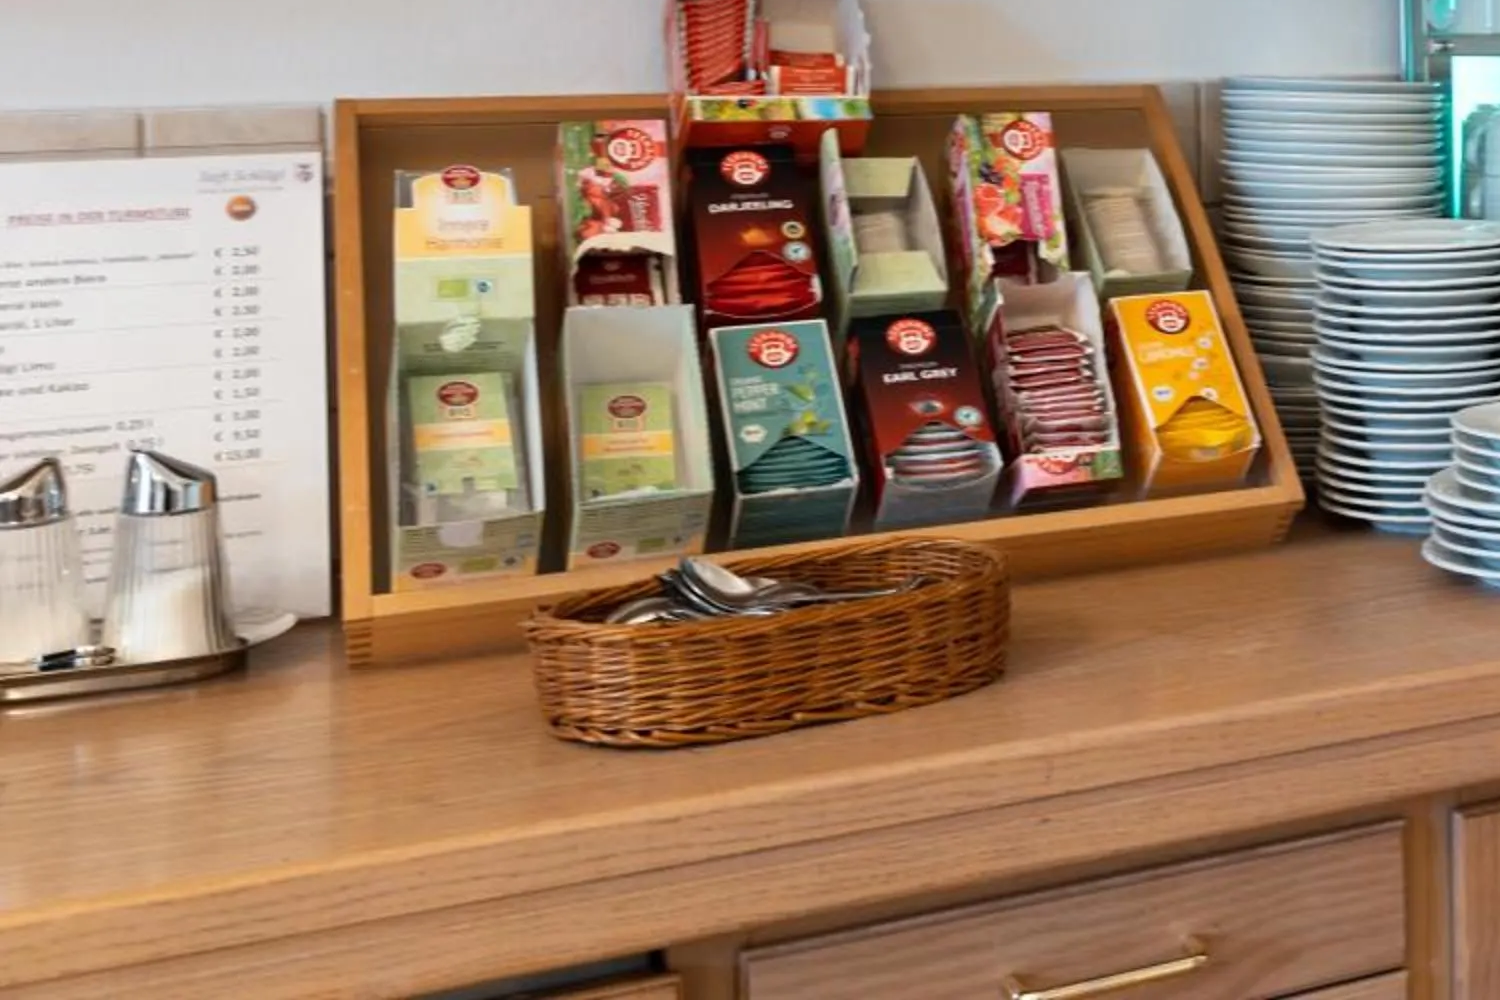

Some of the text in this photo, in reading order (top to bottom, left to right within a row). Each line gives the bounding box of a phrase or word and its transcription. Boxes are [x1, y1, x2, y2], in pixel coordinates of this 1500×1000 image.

[707, 199, 794, 214] DARJEELING
[882, 367, 959, 384] EARL GREY
